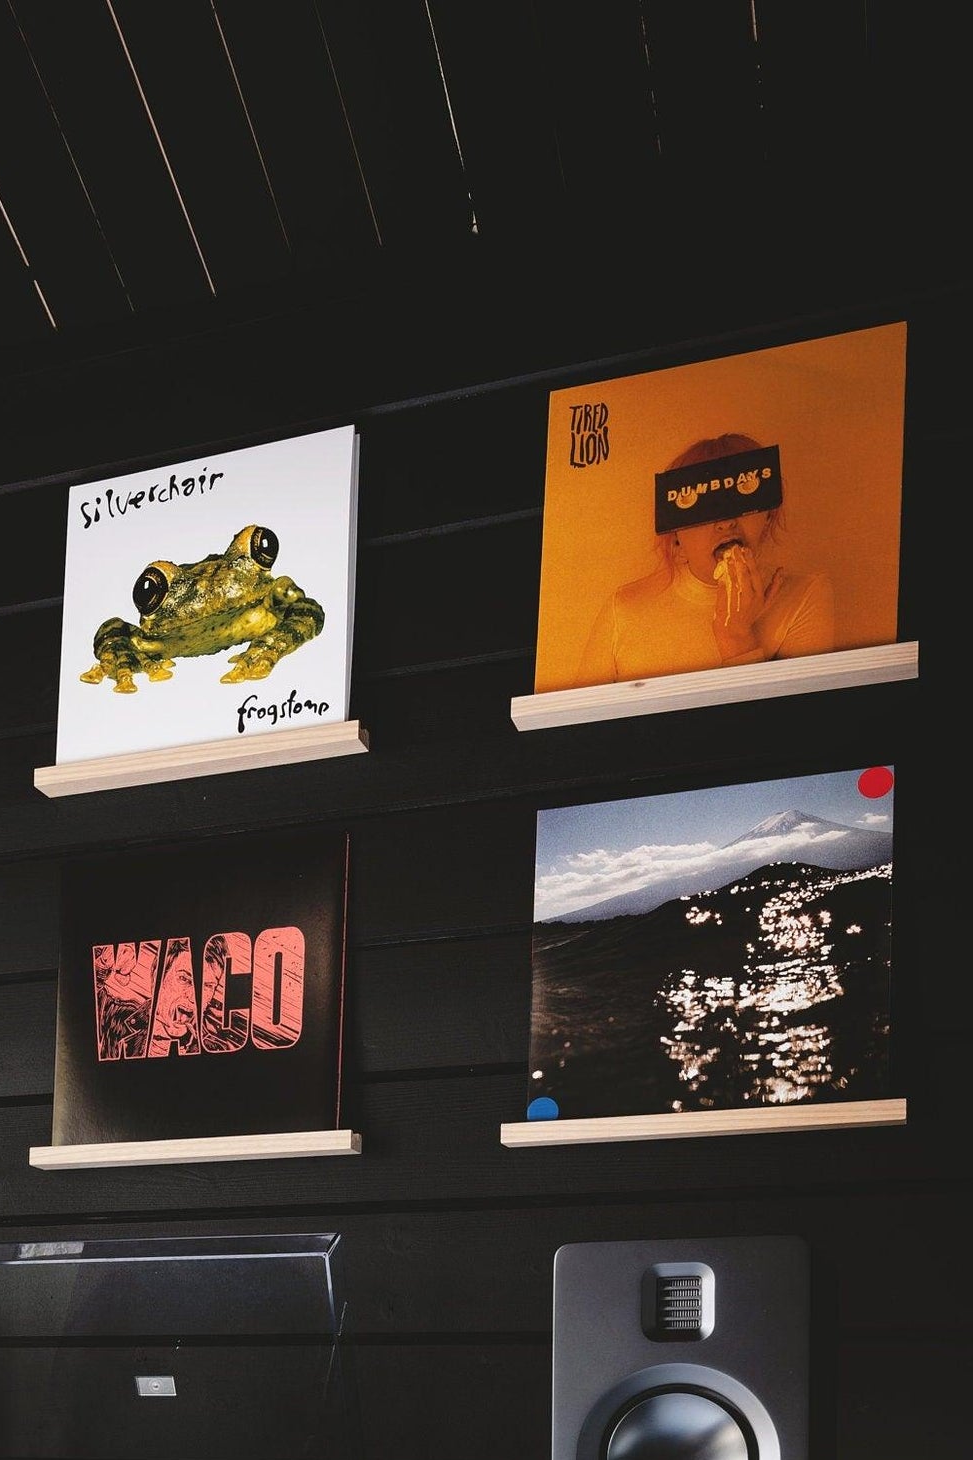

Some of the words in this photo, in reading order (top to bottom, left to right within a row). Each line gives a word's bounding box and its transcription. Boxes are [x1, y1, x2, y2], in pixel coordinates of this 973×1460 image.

[569, 402, 609, 435] TIRED
[569, 426, 610, 468] LION
[80, 466, 224, 529] silverchair
[236, 690, 330, 733] frogstomp
[92, 926, 306, 1062] WACO
